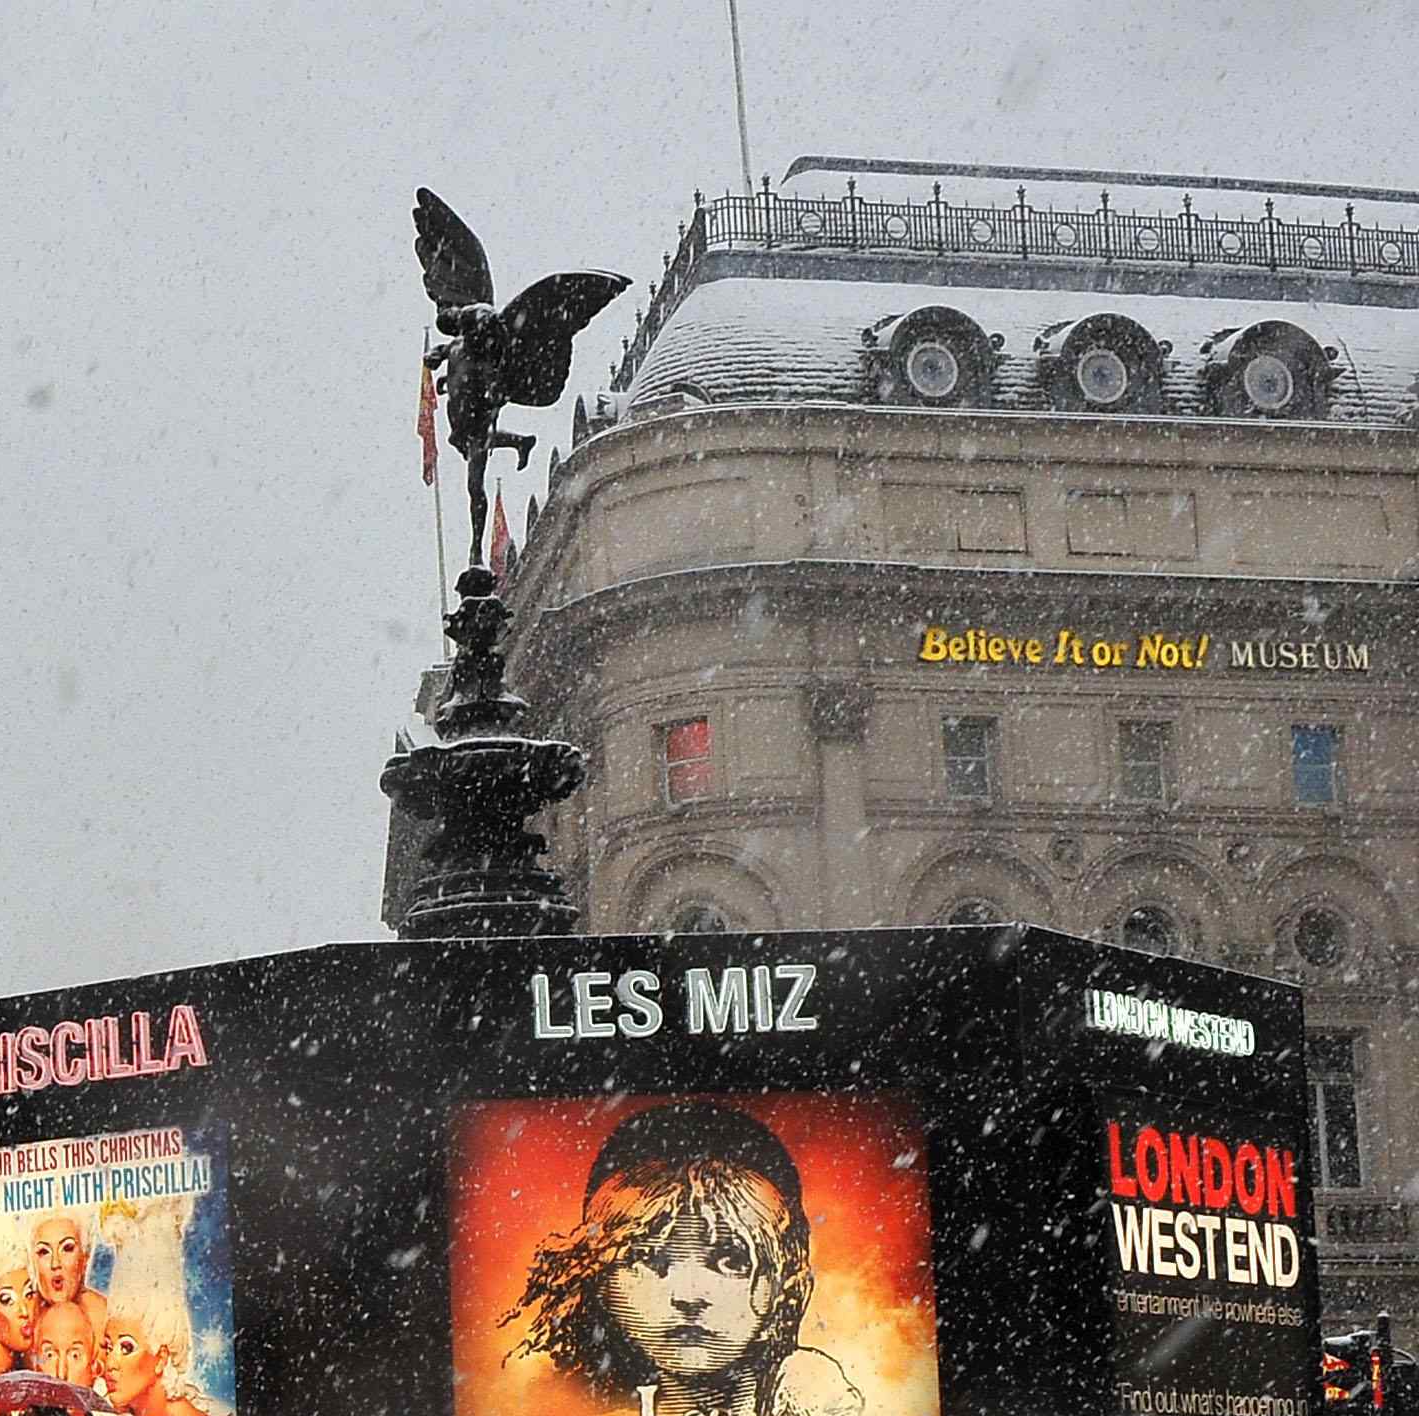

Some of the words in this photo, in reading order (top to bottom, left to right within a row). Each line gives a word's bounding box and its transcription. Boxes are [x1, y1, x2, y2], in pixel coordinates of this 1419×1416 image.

[920, 626, 1044, 663] Believe
[1054, 630, 1084, 665] It
[1093, 640, 1125, 667] or
[1136, 633, 1210, 668] Not!
[1229, 640, 1372, 671] MUSEUM
[530, 968, 662, 1039] LES
[686, 963, 819, 1035] MIZ
[1087, 988, 1169, 1038] LONDON
[17, 1149, 58, 1173] BELLS
[63, 1142, 95, 1169] THIS
[99, 1129, 181, 1166] CHRISTMAS
[1107, 1120, 1297, 1218] LONDON
[3, 1177, 55, 1213] NIGHT
[62, 1170, 105, 1206] WITH
[110, 1158, 210, 1201] PRISCILLA!
[1116, 1290, 1200, 1319] entertainment
[1226, 1300, 1276, 1326] nowhere
[1278, 1303, 1304, 1328] else
[1120, 1382, 1153, 1413] Find
[1155, 1387, 1180, 1415] out
[1180, 1388, 1224, 1416] what's
